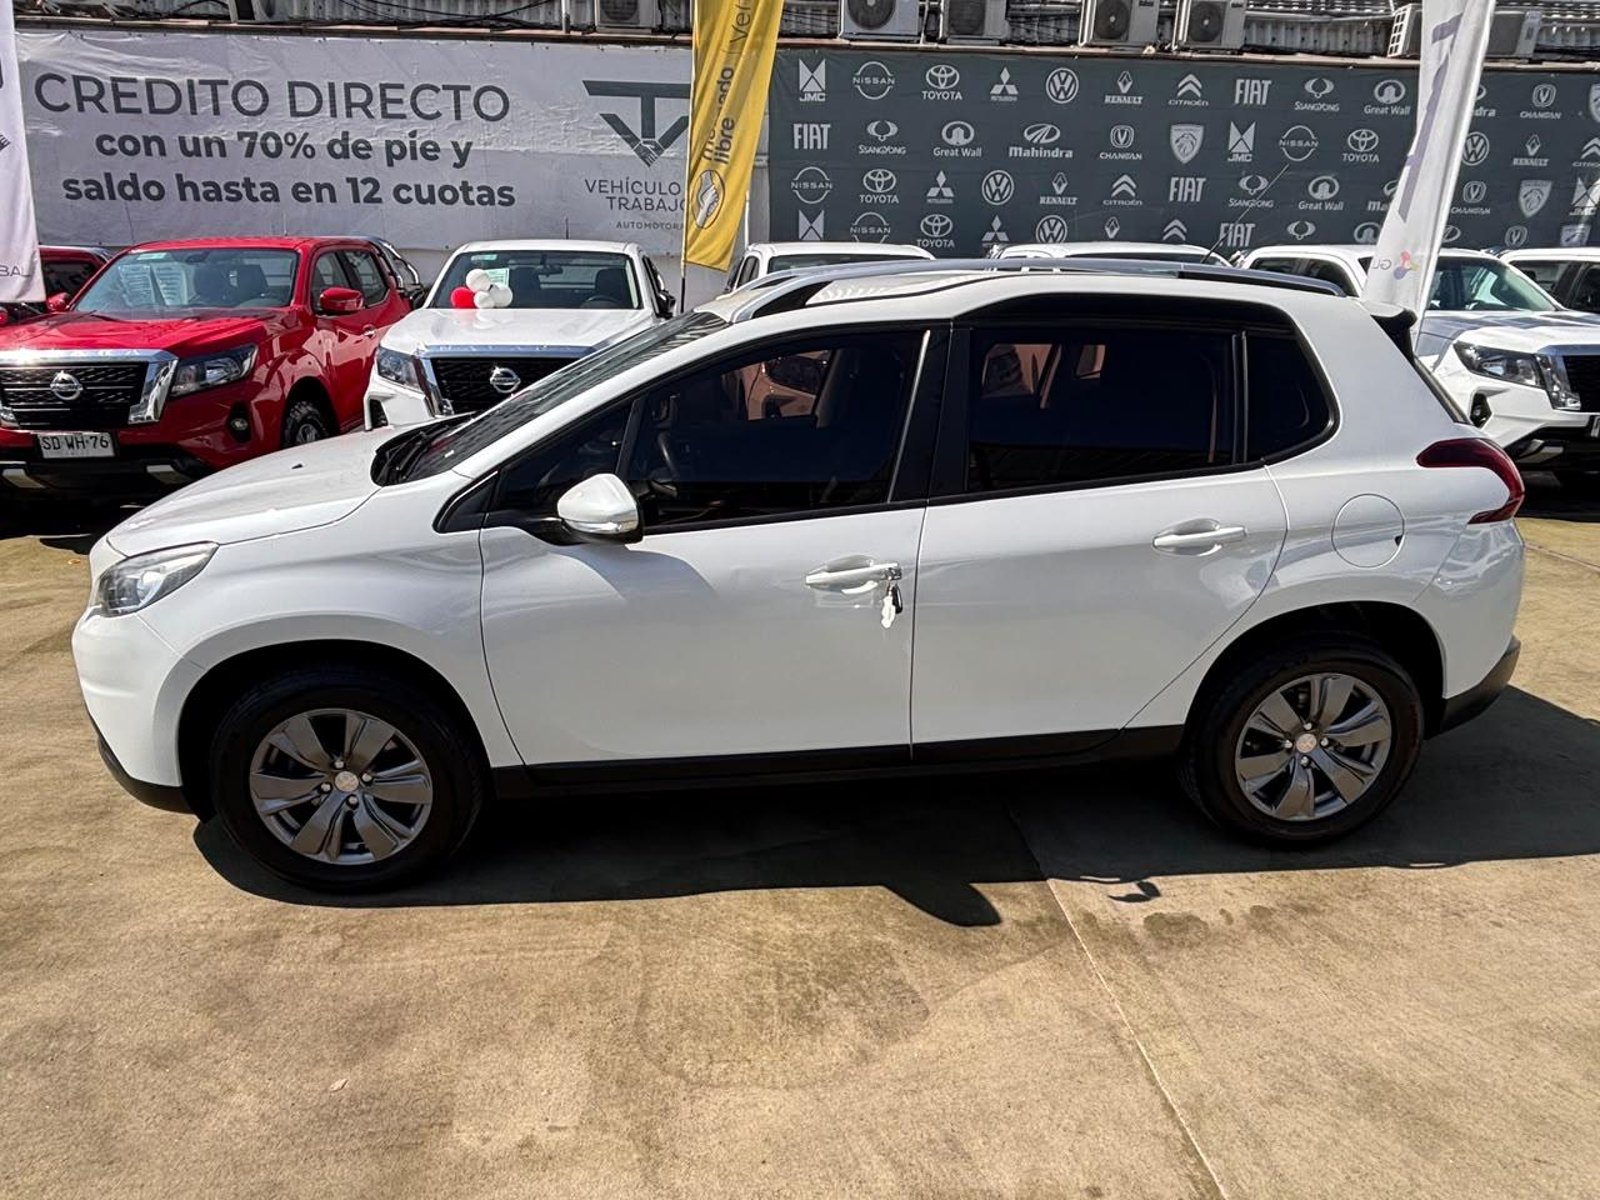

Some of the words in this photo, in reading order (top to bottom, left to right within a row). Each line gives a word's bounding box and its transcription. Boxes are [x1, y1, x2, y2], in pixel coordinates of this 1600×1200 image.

[853, 77, 895, 85] NISSAN
[922, 91, 963, 100] TOYOTA
[1235, 78, 1272, 105] FIAT
[34, 72, 269, 117] CREDITO
[287, 80, 510, 122] DIRECTO
[799, 92, 826, 102] JMC
[1104, 95, 1144, 105] RENAULT
[1364, 105, 1388, 115] Great
[1390, 105, 1411, 116] Wall
[713, 117, 735, 165] libre
[793, 123, 831, 149] FIAT
[1279, 139, 1319, 148] NISSAN
[95, 132, 166, 158] con
[179, 135, 226, 158] un
[237, 131, 316, 160] 70%
[327, 131, 373, 160] de
[450, 141, 473, 169] y
[933, 147, 959, 157] Great
[961, 147, 982, 157] Wall
[1008, 146, 1073, 158] Mahindra
[1227, 153, 1252, 162] JMC
[1342, 153, 1380, 163] TOYOTA
[62, 172, 166, 201] saldo
[175, 173, 280, 203] hasta
[291, 181, 337, 204] en
[346, 177, 383, 204] 12
[392, 179, 516, 207] cuotas
[791, 182, 832, 190] NISSAN
[1169, 177, 1206, 202] FIAT
[859, 194, 899, 204] TOYOTA
[1298, 201, 1323, 210] Great
[1324, 201, 1344, 211] Wall
[850, 226, 891, 234] NISSAN
[1219, 223, 1256, 247] FIAT
[917, 239, 955, 248] TOYOTA
